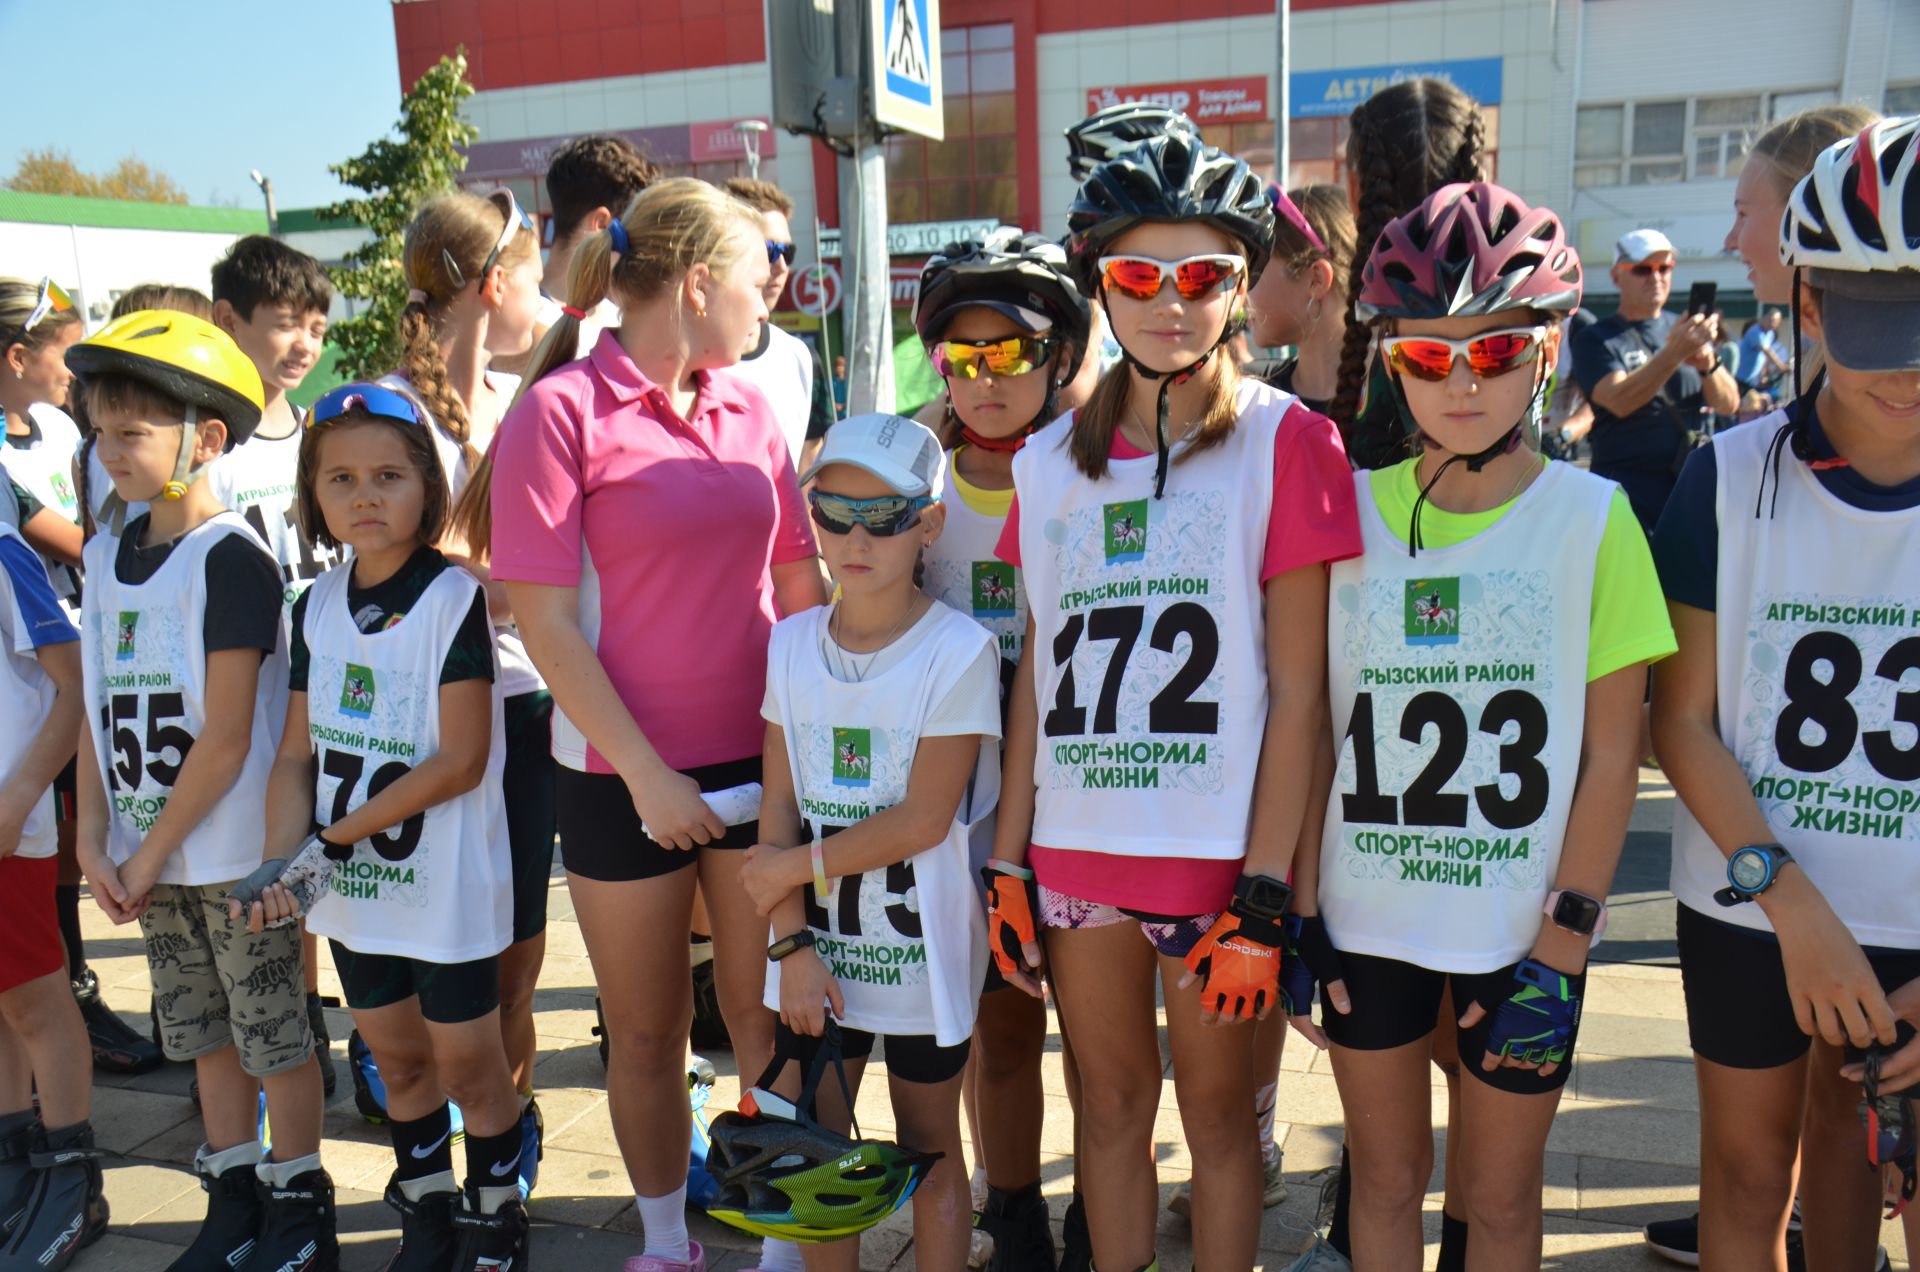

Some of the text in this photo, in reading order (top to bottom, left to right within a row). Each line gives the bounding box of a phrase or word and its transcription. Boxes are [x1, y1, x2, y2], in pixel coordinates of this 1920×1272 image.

[1147, 572, 1209, 596] РАЙОН
[1766, 602, 1905, 628] АГРЫЗСКИЙ
[1044, 602, 1219, 737] 172
[1465, 658, 1535, 683] РАЙОН
[1775, 631, 1920, 781] 83
[368, 736, 416, 757] РАЙОН
[1115, 742, 1207, 764] НОРМА
[1341, 689, 1550, 830] 123
[1083, 768, 1159, 788] ЖИЗНИ
[1790, 805, 1903, 839] ЖИЗНИ
[1355, 832, 1529, 860] СПОРТ НОРМА
[1400, 859, 1482, 887] ЖИЗНИ
[831, 959, 902, 985] ЖИЗНИ
[272, 1191, 314, 1199] SPINE
[38, 1212, 84, 1266] SPINE
